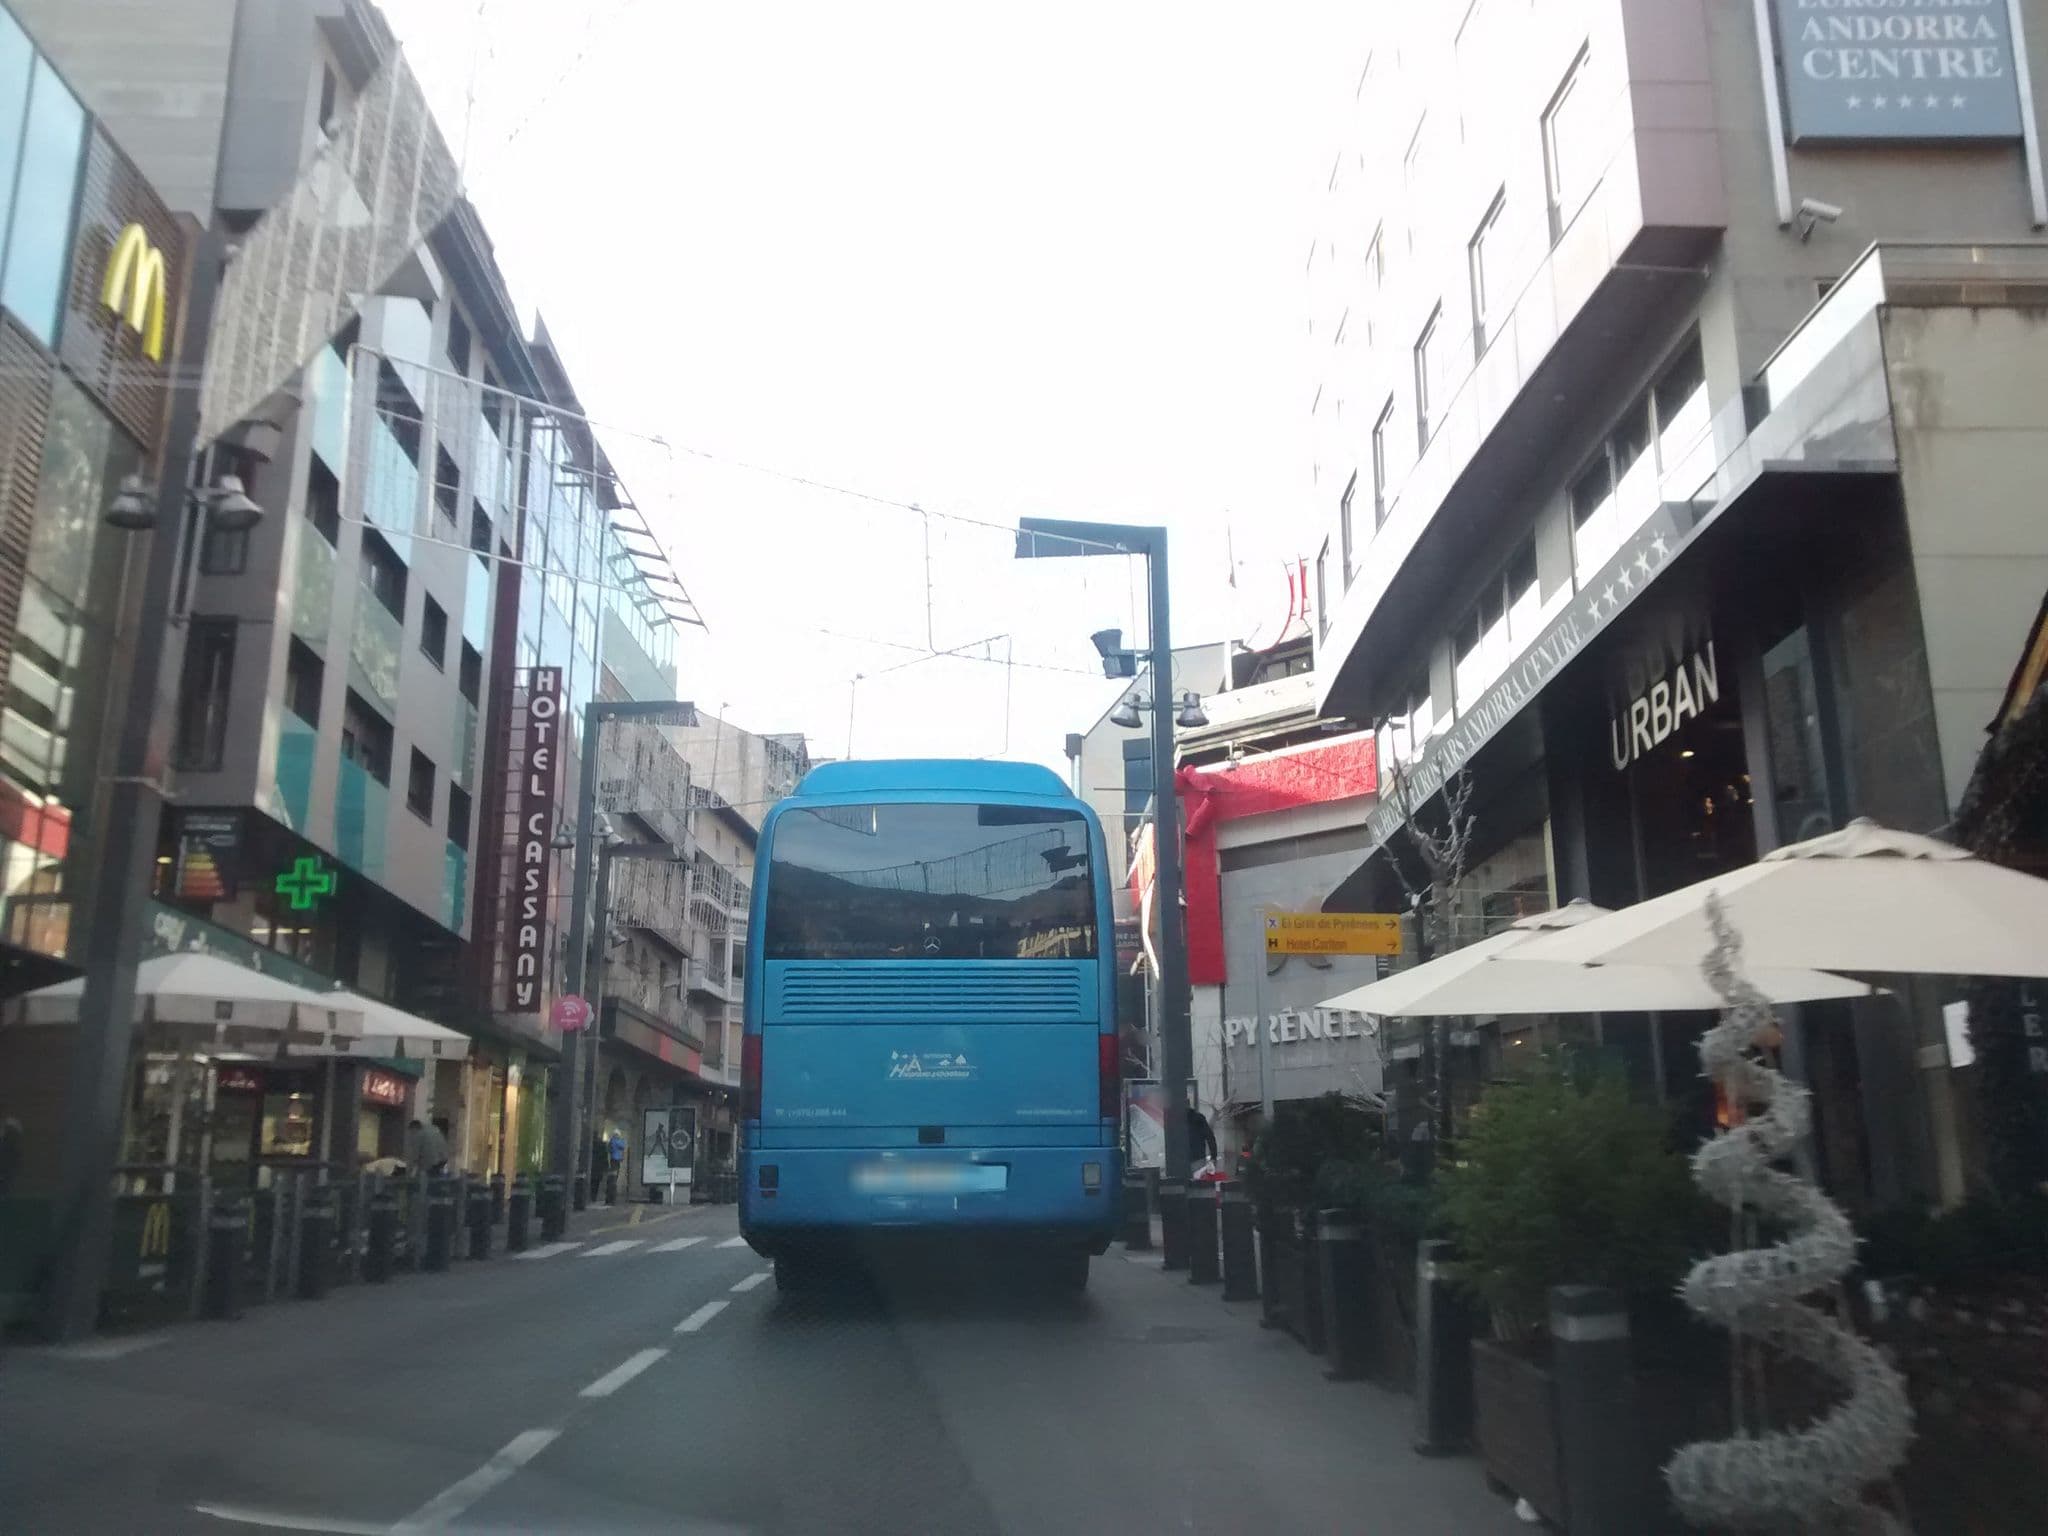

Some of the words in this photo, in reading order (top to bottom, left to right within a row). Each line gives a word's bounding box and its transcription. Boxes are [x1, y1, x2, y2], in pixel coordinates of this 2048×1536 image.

[1801, 14, 1998, 41] ANDORRA
[1802, 48, 2002, 80] CENTRE
[531, 671, 556, 797] HOTEL
[1463, 678, 1525, 747] ANDORRA
[1522, 611, 1586, 699] CENTRE
[1612, 640, 1719, 770] URBAN
